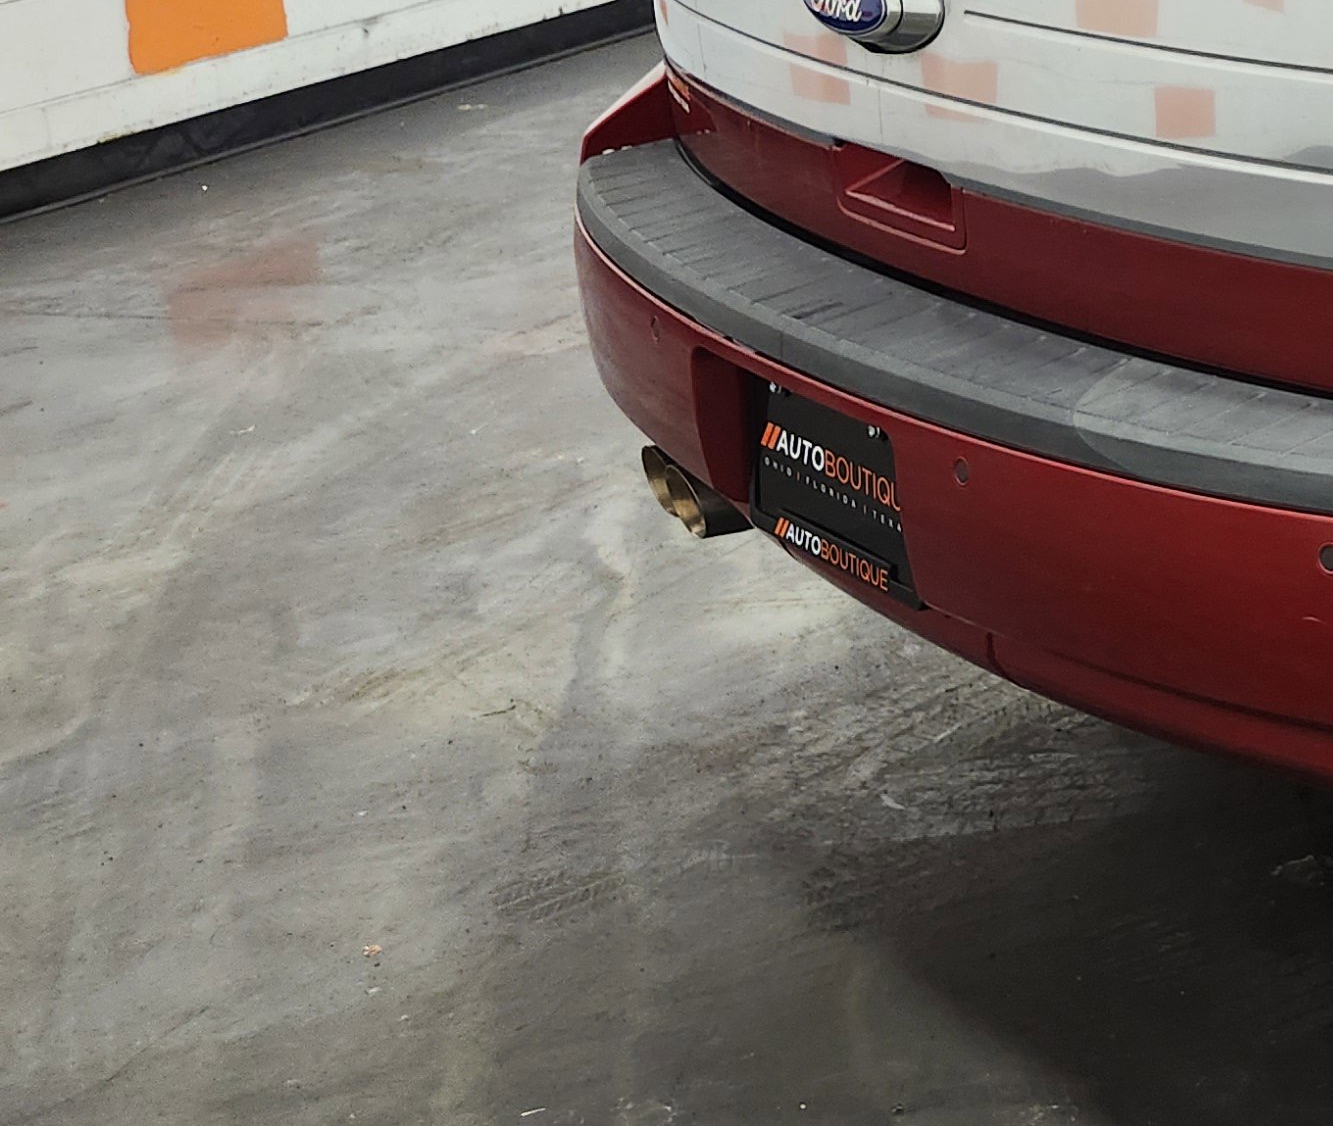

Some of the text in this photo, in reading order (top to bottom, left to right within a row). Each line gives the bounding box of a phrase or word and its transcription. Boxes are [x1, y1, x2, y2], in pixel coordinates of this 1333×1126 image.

[764, 456, 903, 533] OHIO FLORIDA TEXA
[775, 429, 902, 512] AUTOBOUTIQU
[785, 523, 889, 592] AUTOBOUTIQUE
